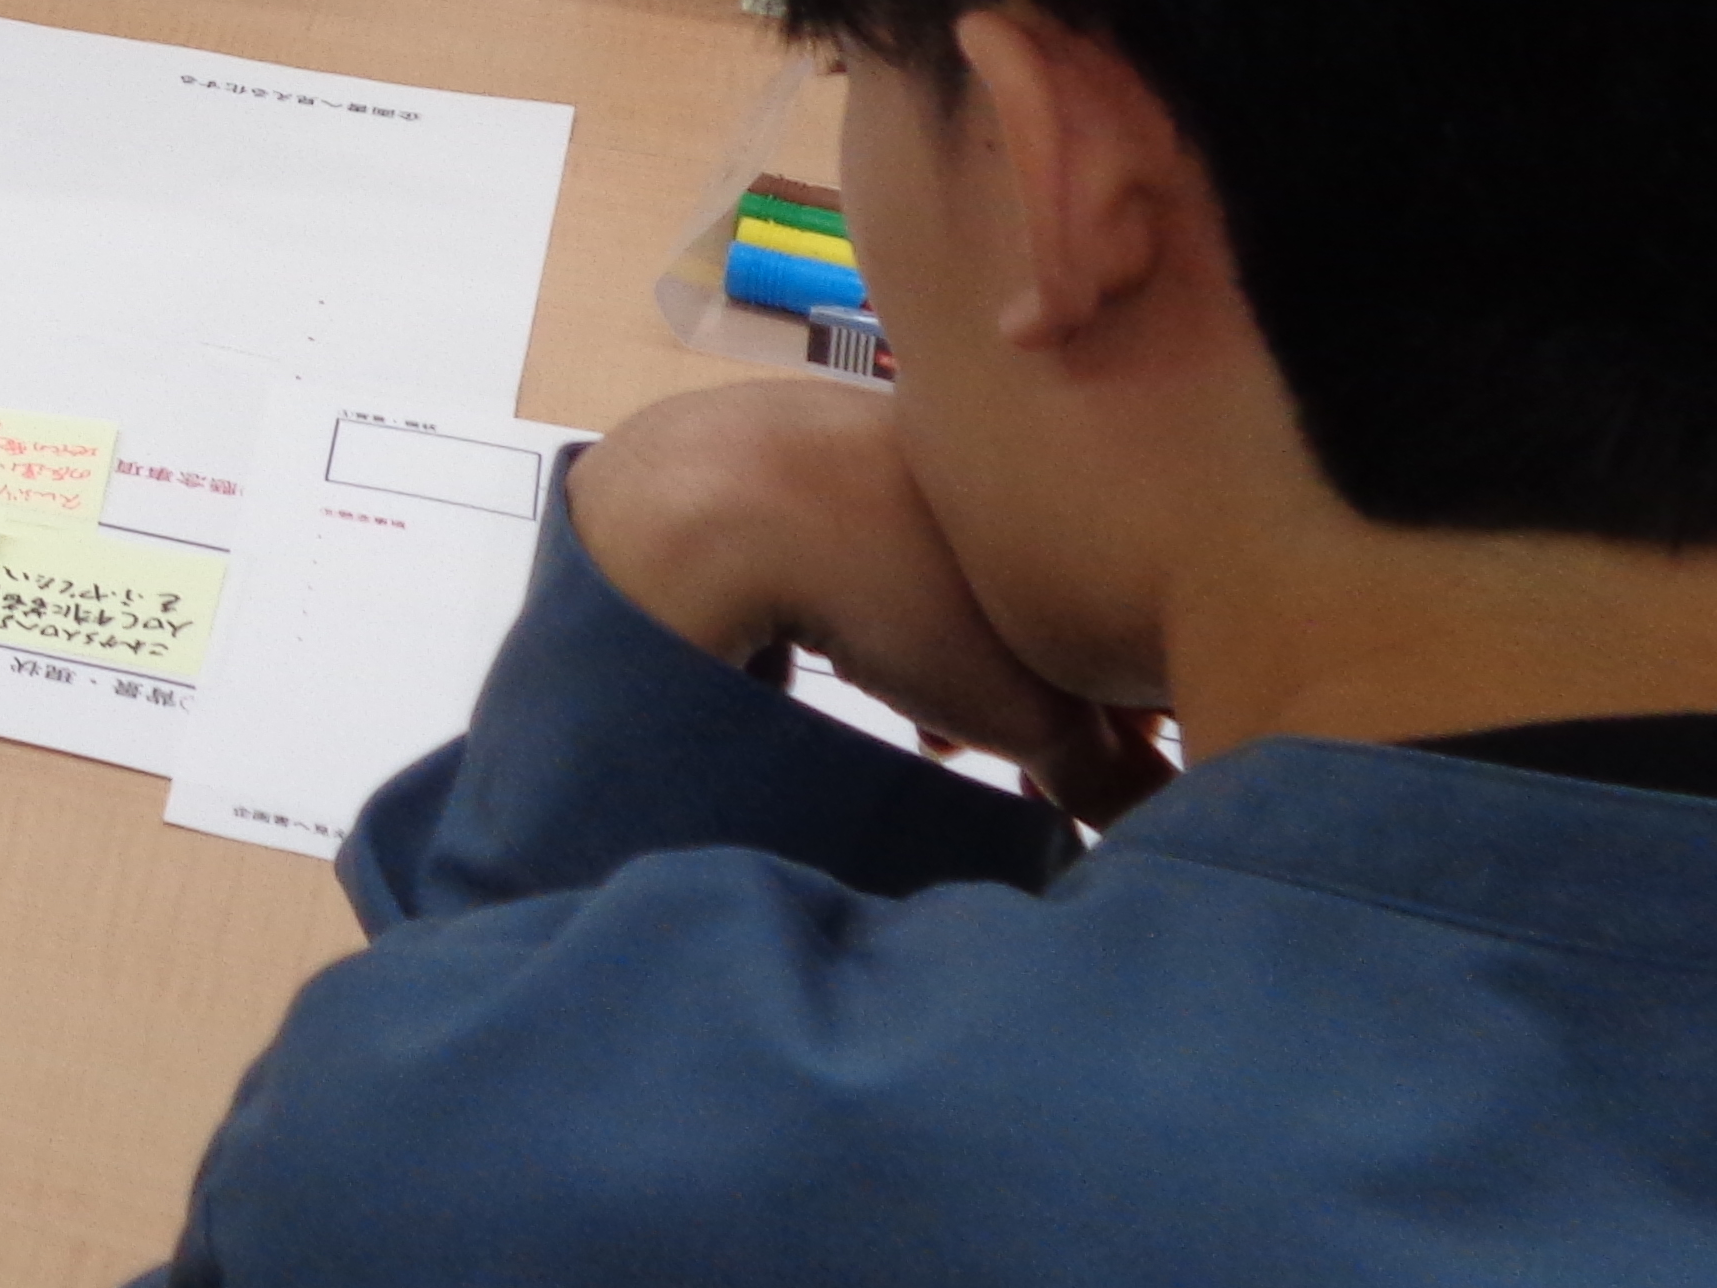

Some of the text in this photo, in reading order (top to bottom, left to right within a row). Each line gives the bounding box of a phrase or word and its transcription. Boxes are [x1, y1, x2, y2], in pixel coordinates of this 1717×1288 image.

[180, 75, 422, 122] 企画書へ見える化する
[116, 459, 243, 498] 懸念事項
[10, 656, 193, 712] 背景・現状
